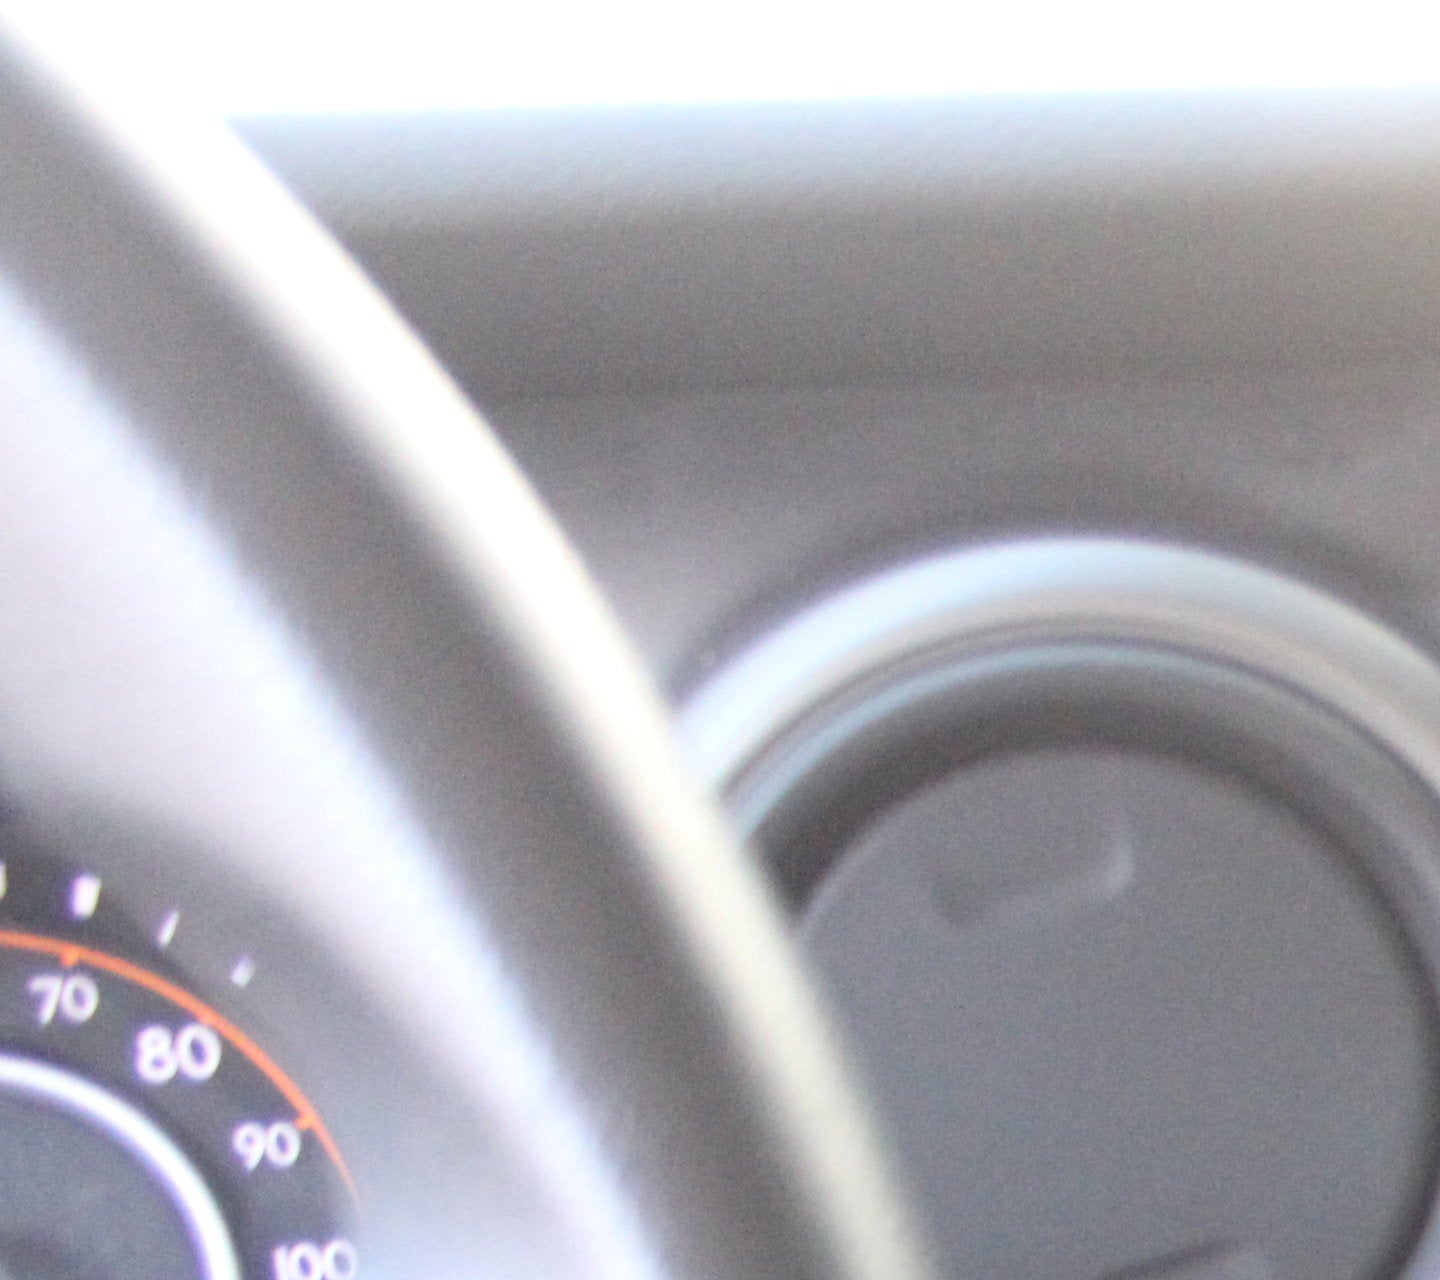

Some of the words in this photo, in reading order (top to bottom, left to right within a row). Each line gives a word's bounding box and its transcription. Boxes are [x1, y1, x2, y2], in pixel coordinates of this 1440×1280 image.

[28, 974, 99, 1025] 70
[134, 1022, 222, 1085] 80
[233, 1121, 300, 1171] 90
